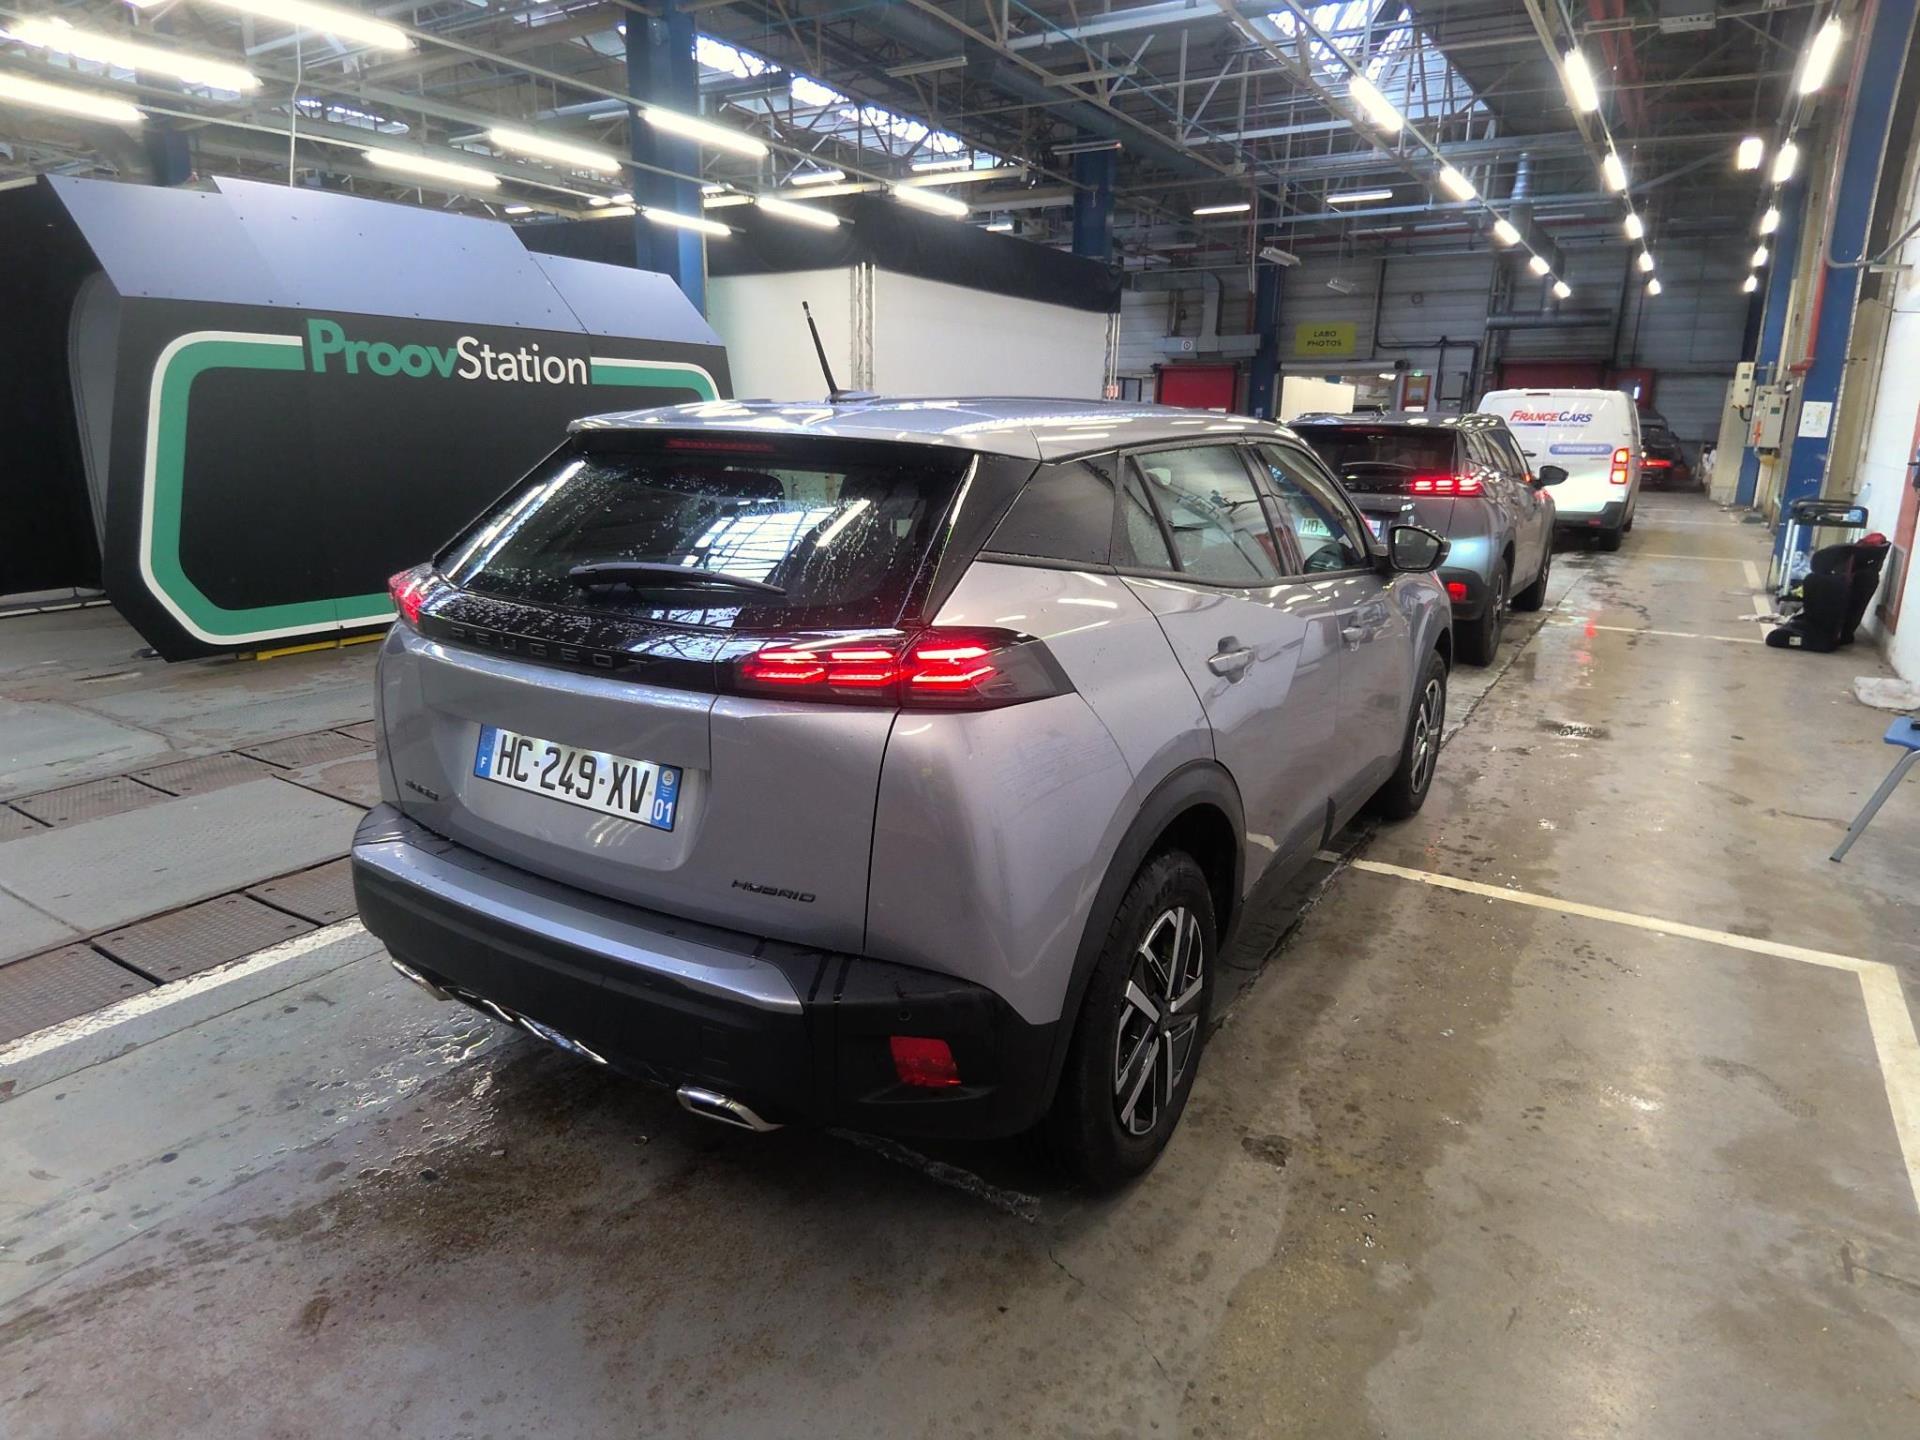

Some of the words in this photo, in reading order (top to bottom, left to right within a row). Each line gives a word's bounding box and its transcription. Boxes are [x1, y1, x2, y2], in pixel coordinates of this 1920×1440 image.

[1313, 330, 1337, 338] LABO
[307, 319, 587, 385] ProovStation
[1306, 340, 1343, 348] PHOTOS
[451, 627, 648, 672] PEUGEOT
[480, 756, 487, 768] F
[653, 798, 673, 823] 01
